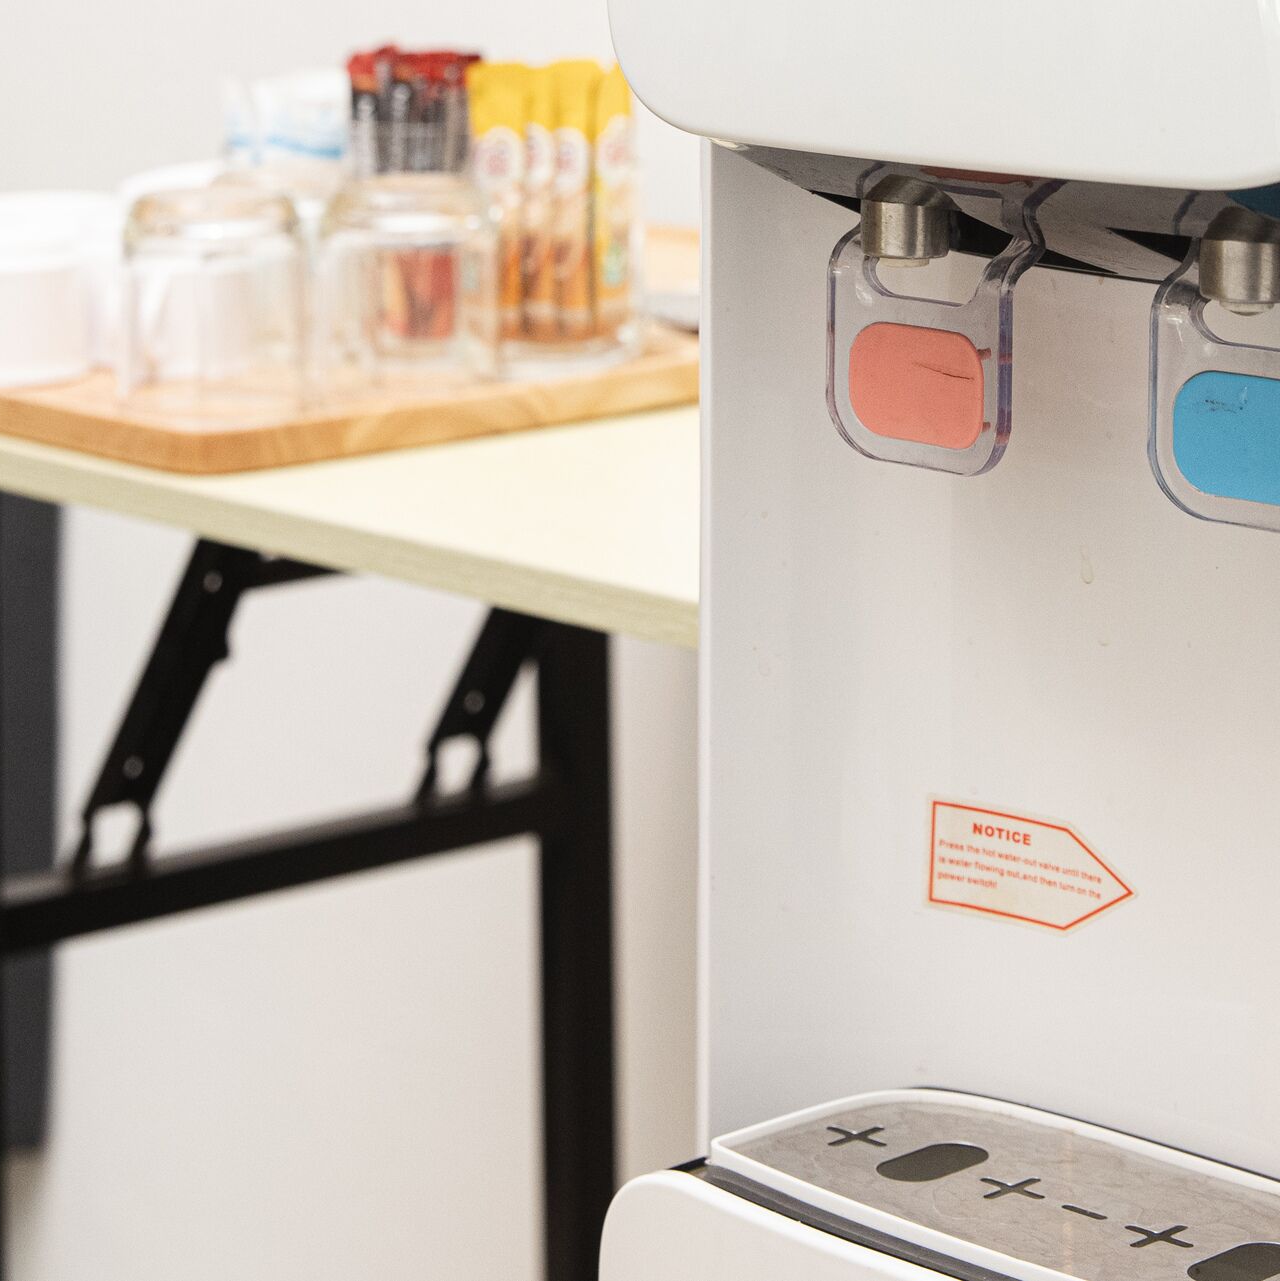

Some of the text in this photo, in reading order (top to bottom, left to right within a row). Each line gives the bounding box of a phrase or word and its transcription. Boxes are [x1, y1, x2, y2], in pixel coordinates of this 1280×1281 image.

[972, 822, 1031, 846] NOTICE
[948, 858, 972, 868] water
[1039, 876, 1057, 889] then
